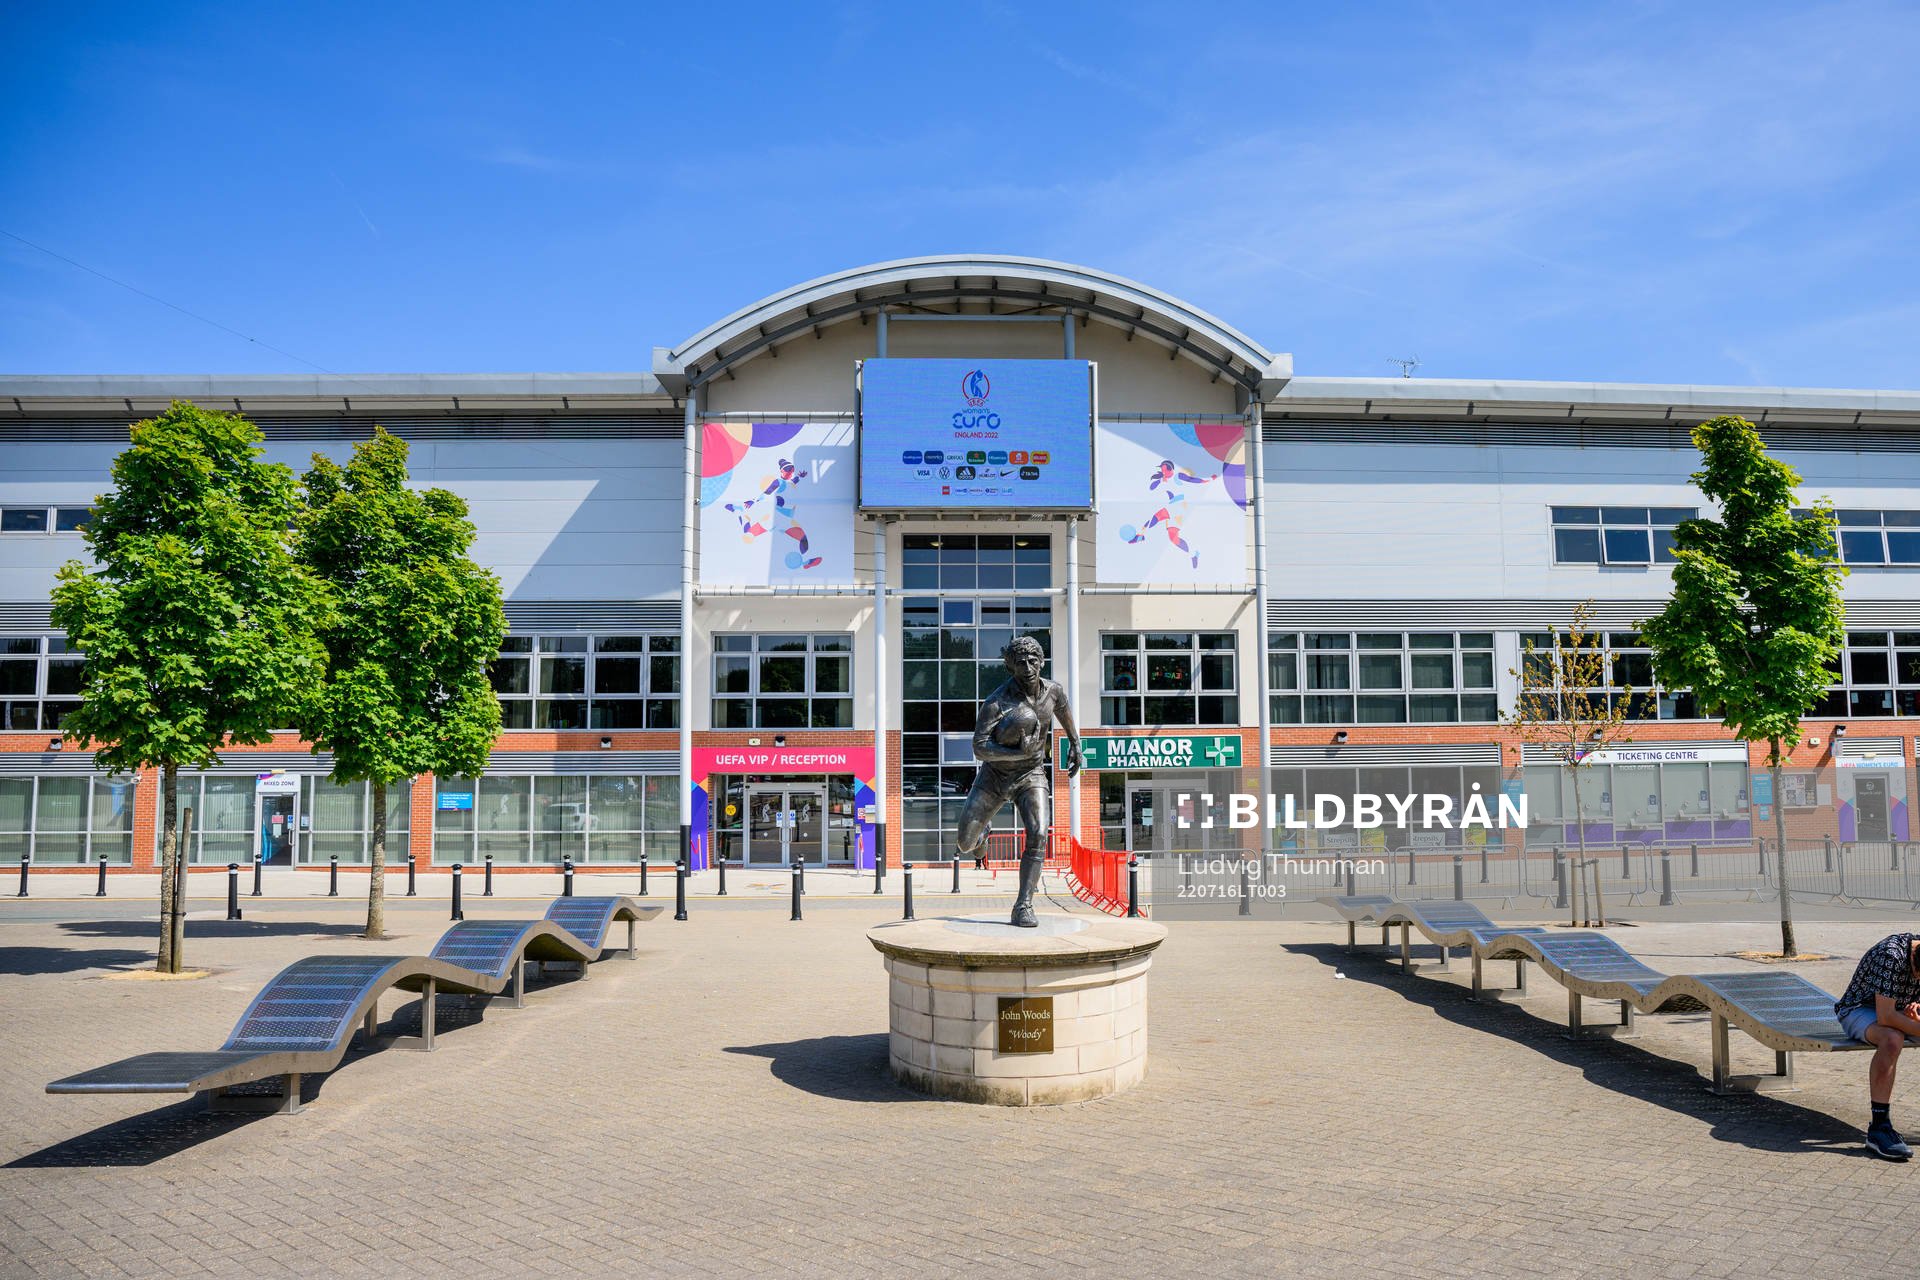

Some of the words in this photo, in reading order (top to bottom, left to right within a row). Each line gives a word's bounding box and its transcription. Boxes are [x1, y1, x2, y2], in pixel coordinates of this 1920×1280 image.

[1107, 739, 1193, 756] MANOR
[715, 754, 746, 765] UEFA
[748, 754, 769, 765] VIP
[780, 754, 847, 765] RECEPTION
[1617, 752, 1662, 760] TICKETING
[1665, 751, 1698, 759] CENTRE
[1107, 756, 1193, 767] PHARMACY
[1001, 1010, 1021, 1020] John
[1022, 1009, 1051, 1020] Woods
